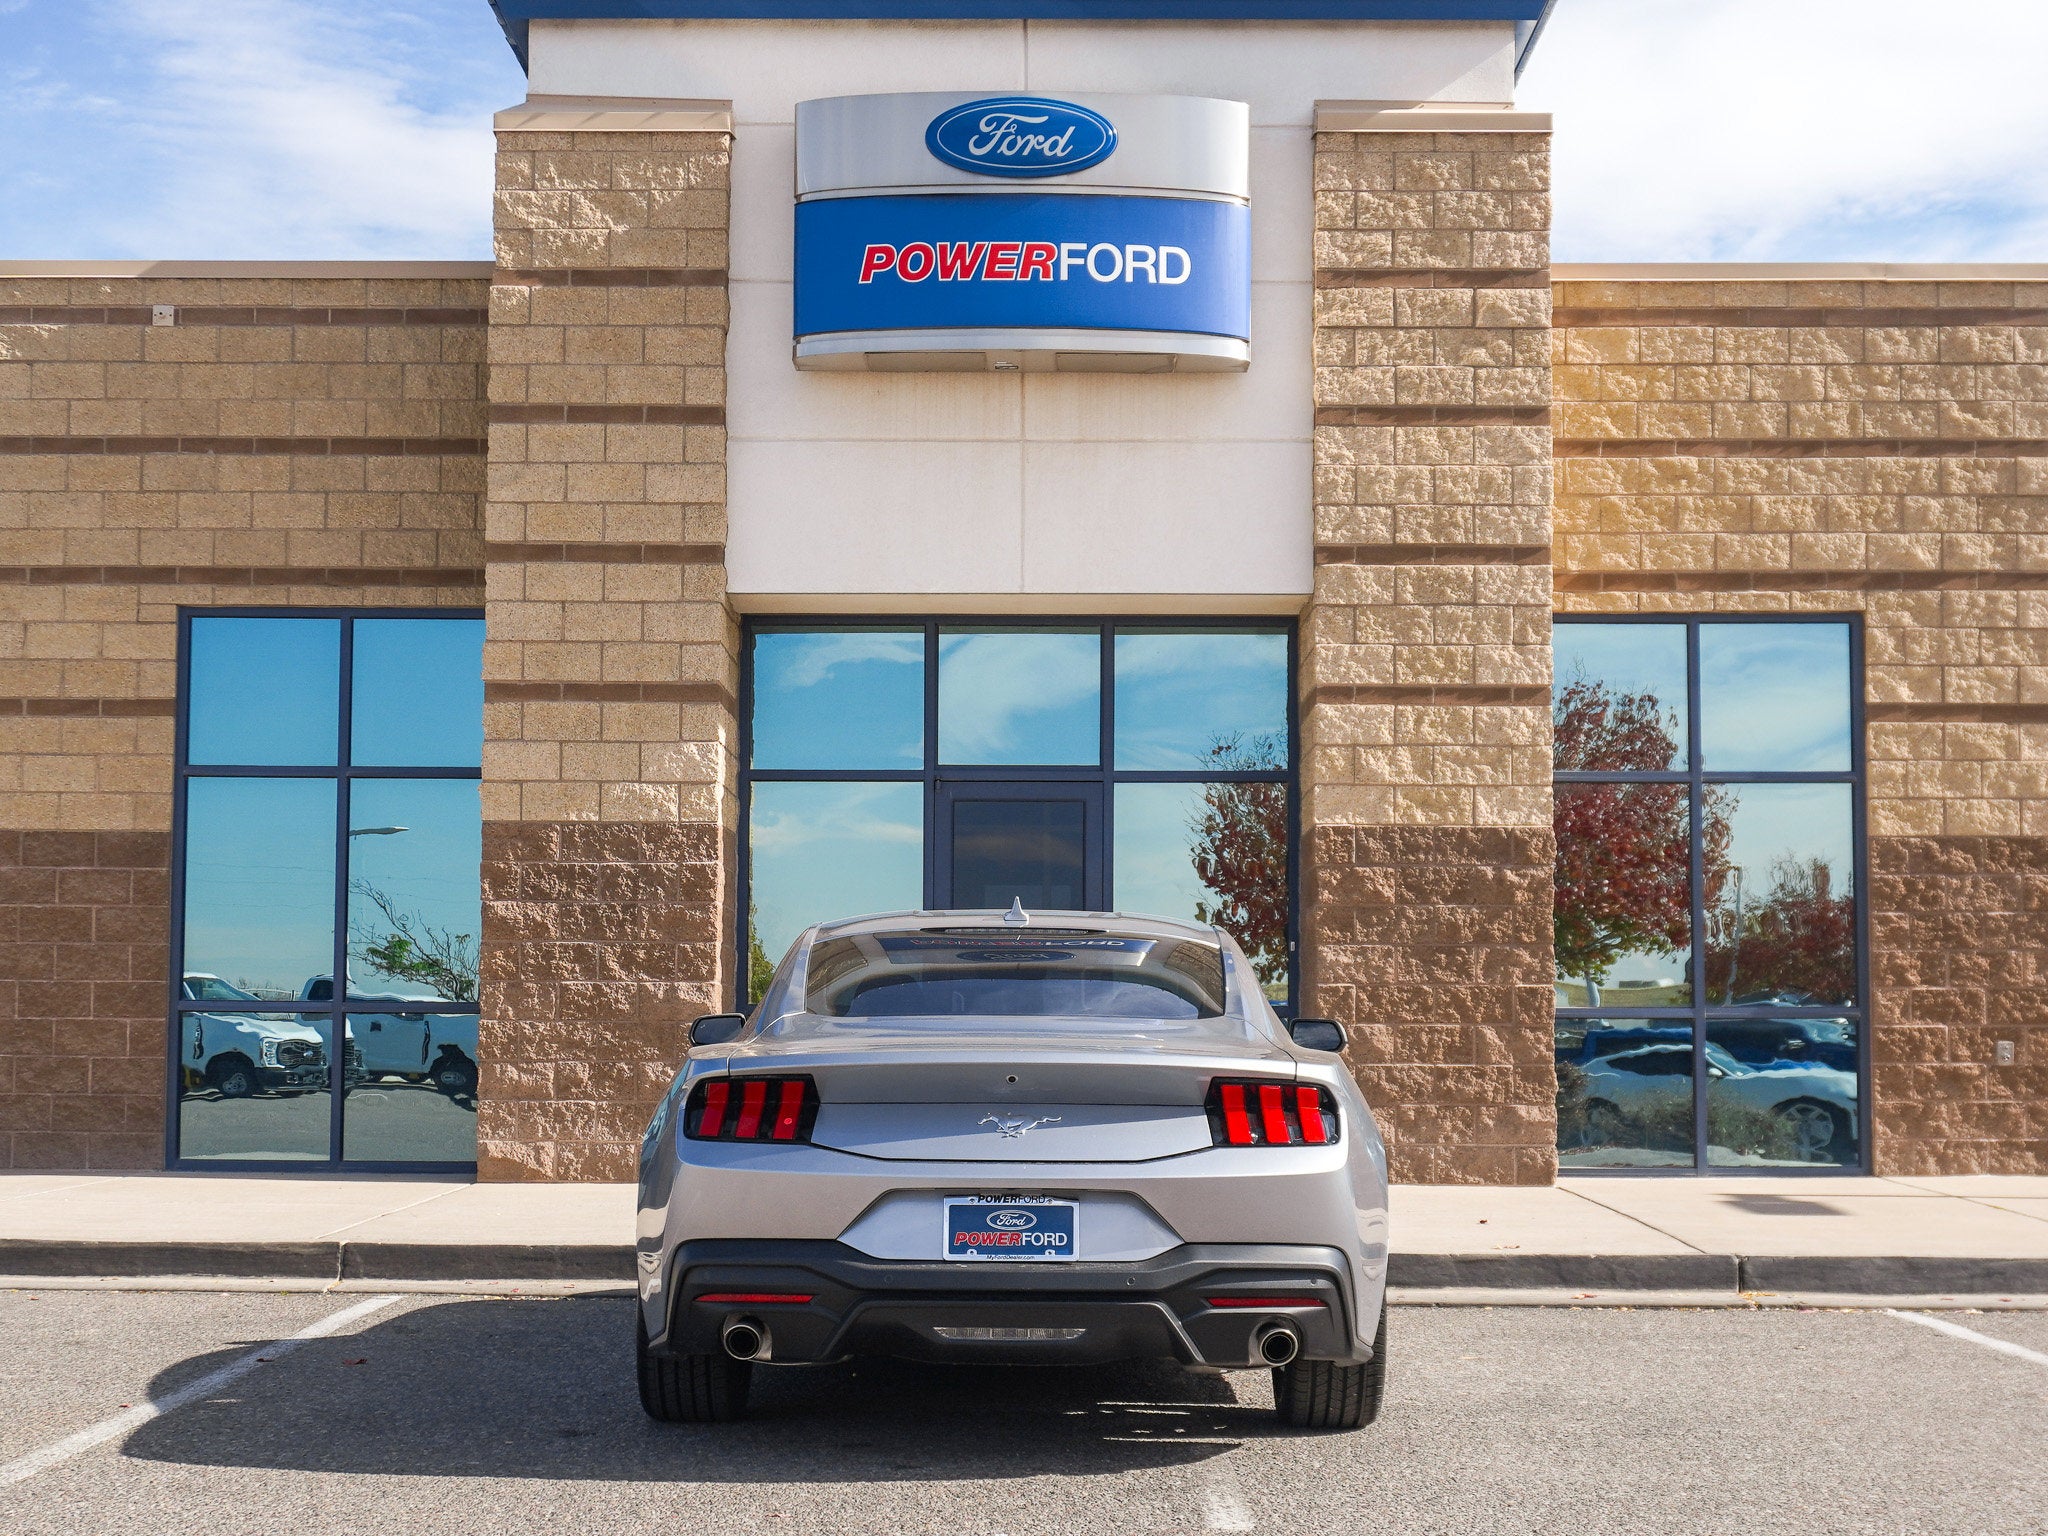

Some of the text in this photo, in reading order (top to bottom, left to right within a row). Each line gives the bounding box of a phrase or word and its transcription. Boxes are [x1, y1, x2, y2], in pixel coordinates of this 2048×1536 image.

[968, 112, 1074, 157] Ford
[858, 241, 1192, 285] POWERFORD
[977, 1194, 1046, 1204] POWERFORD
[996, 1213, 1026, 1226] Ford
[954, 1231, 1068, 1247] POWERFORD
